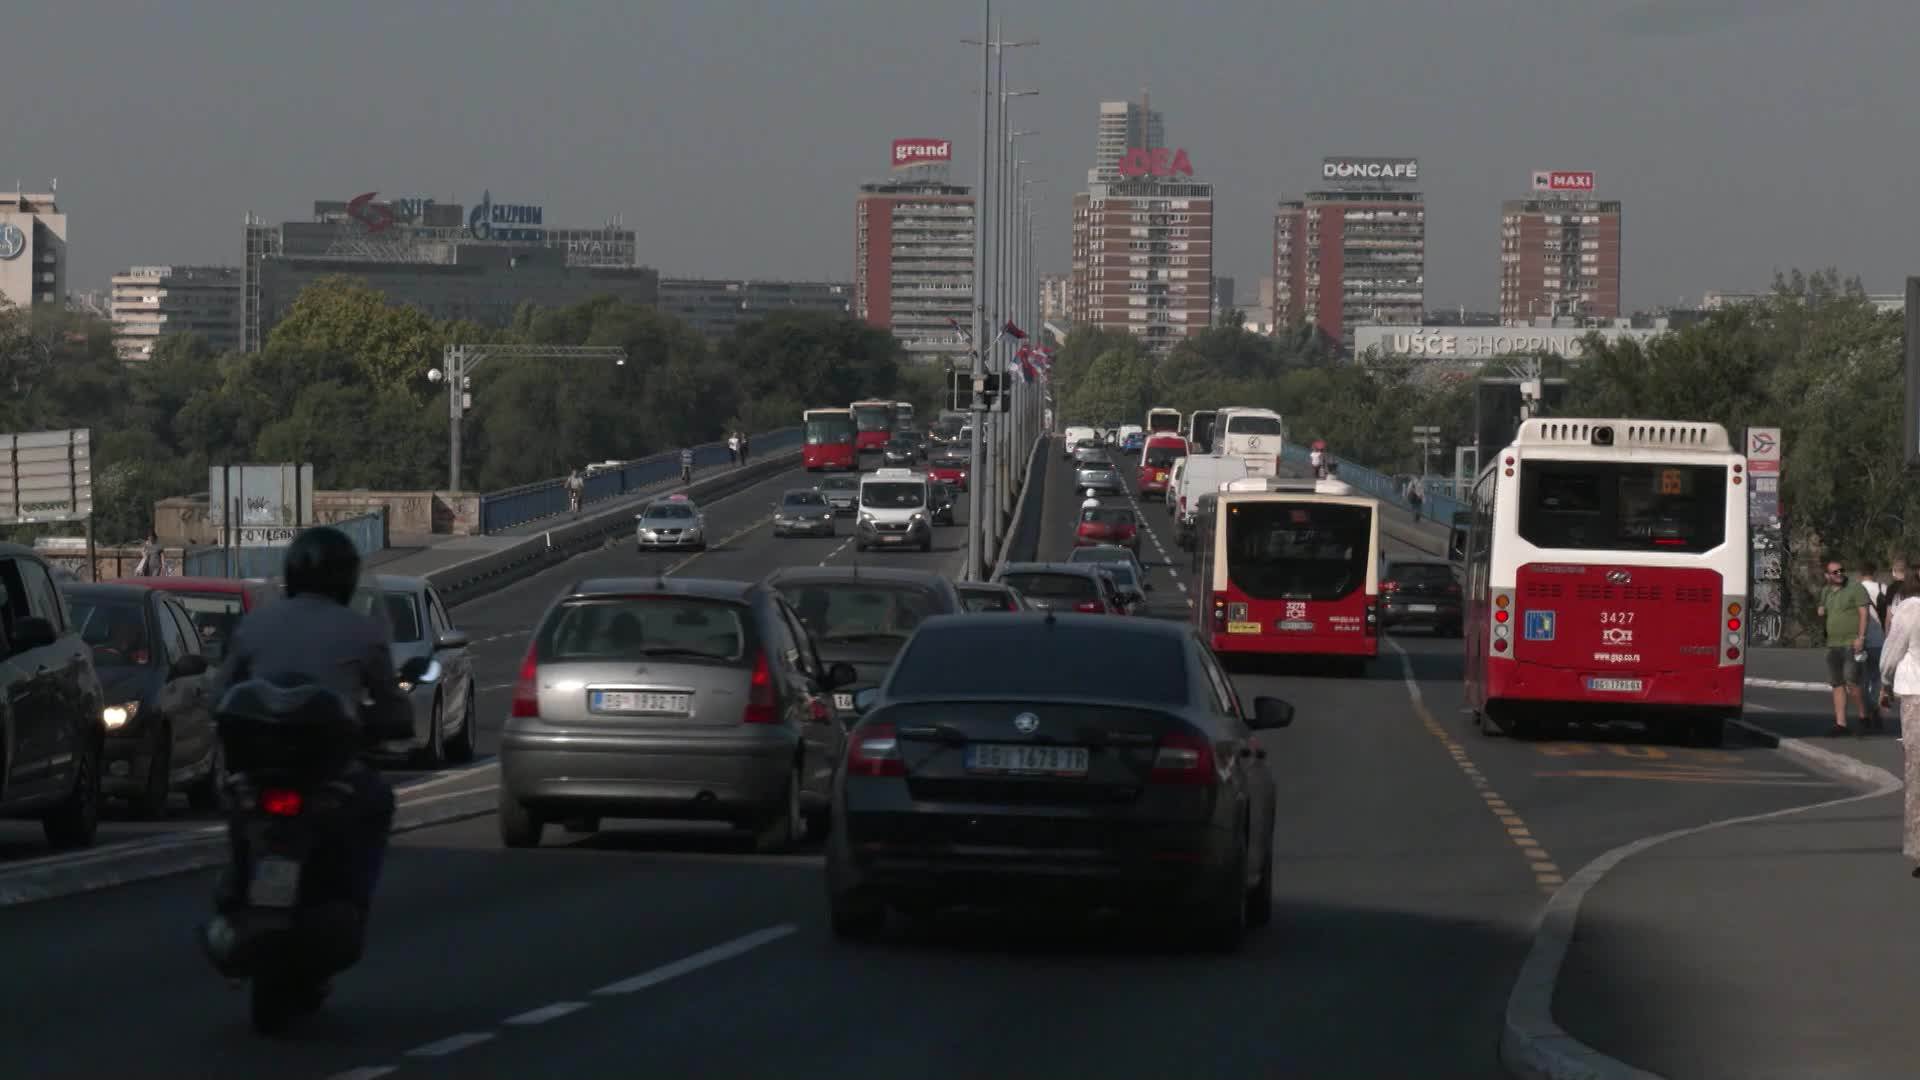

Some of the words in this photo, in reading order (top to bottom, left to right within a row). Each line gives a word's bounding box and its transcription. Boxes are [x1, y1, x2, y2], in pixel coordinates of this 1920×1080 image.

[896, 142, 948, 160] grand
[1324, 160, 1418, 178] DONCAFÉ
[1553, 174, 1591, 188] MAXI
[1600, 612, 1634, 624] 3427
[1593, 652, 1641, 663] www.gsp.co.rs
